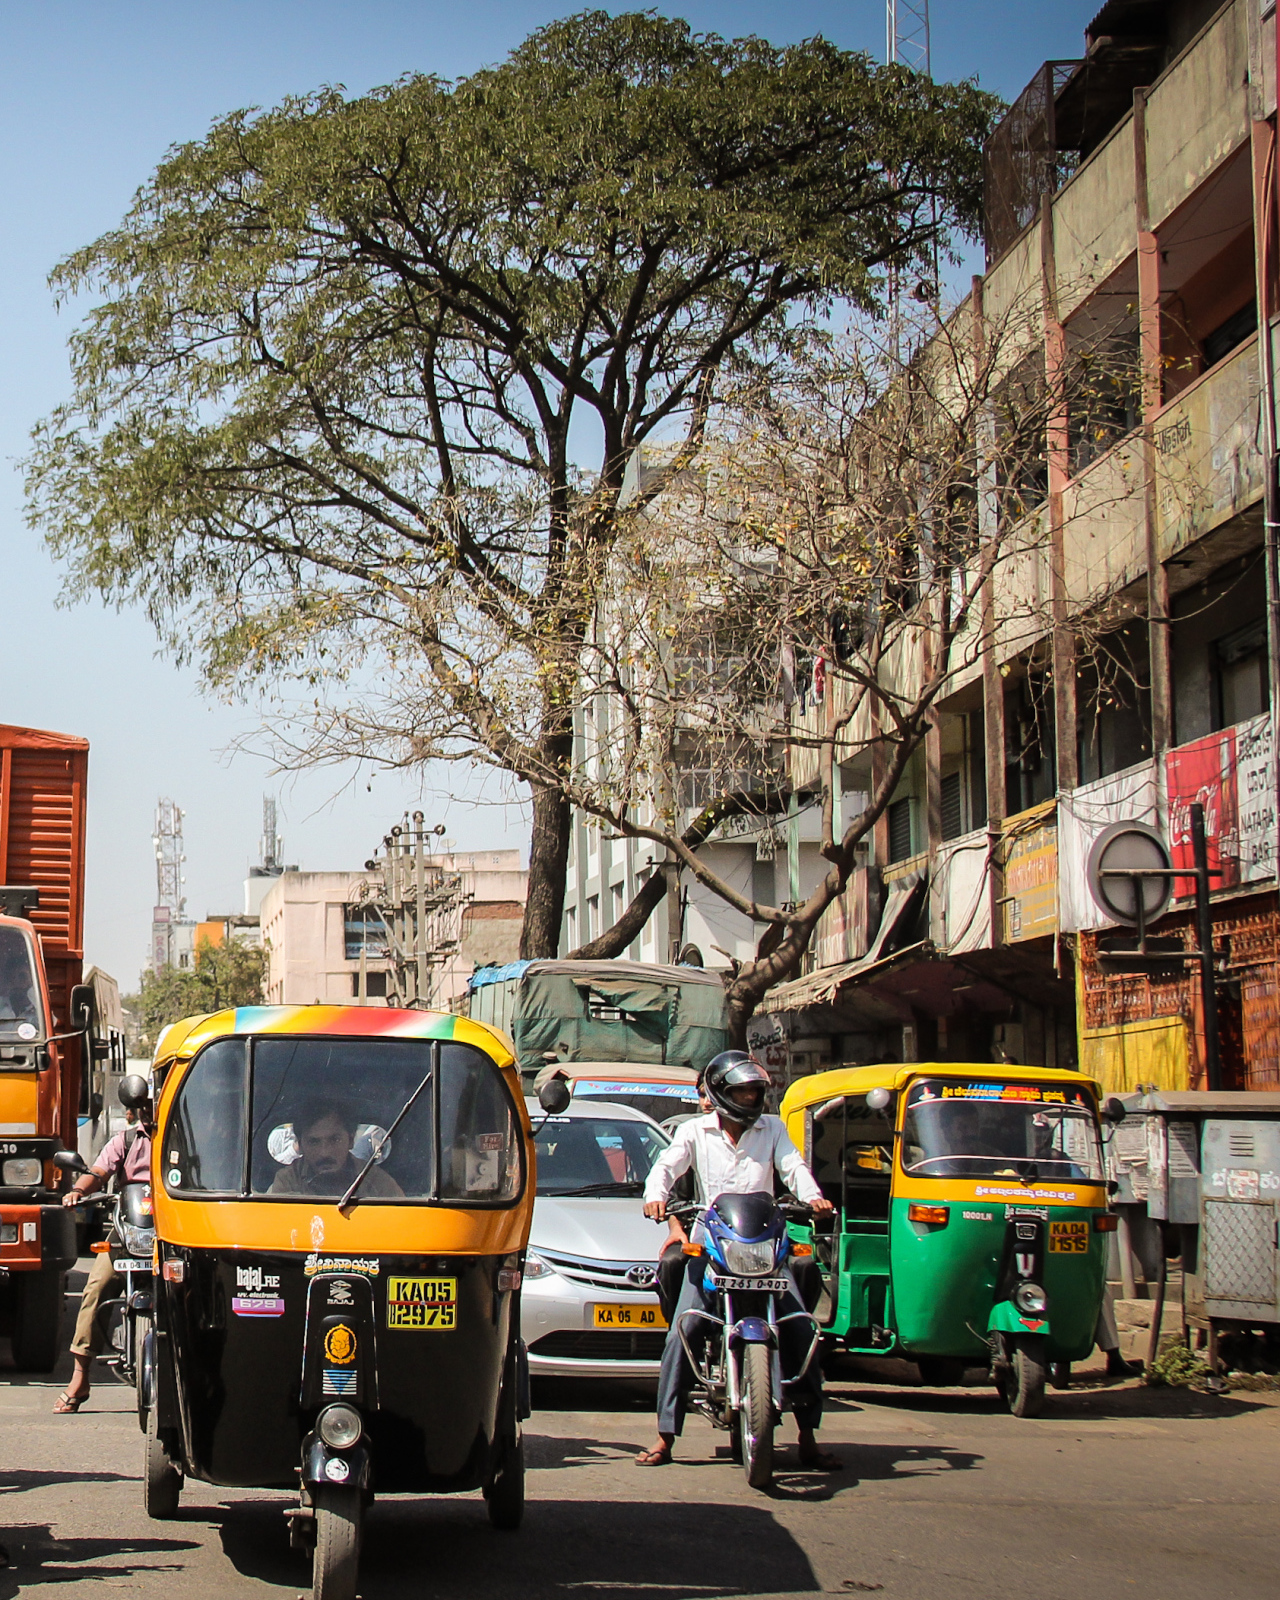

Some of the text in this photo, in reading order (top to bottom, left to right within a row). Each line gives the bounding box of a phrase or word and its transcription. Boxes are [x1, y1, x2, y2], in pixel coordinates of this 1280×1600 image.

[1241, 807, 1275, 834] NATARA
[1252, 841, 1269, 865] BAR
[714, 1278, 726, 1287] HR
[396, 1282, 451, 1302] KA05
[240, 1299, 276, 1308] 679
[598, 1310, 655, 1323] KA 05 AD
